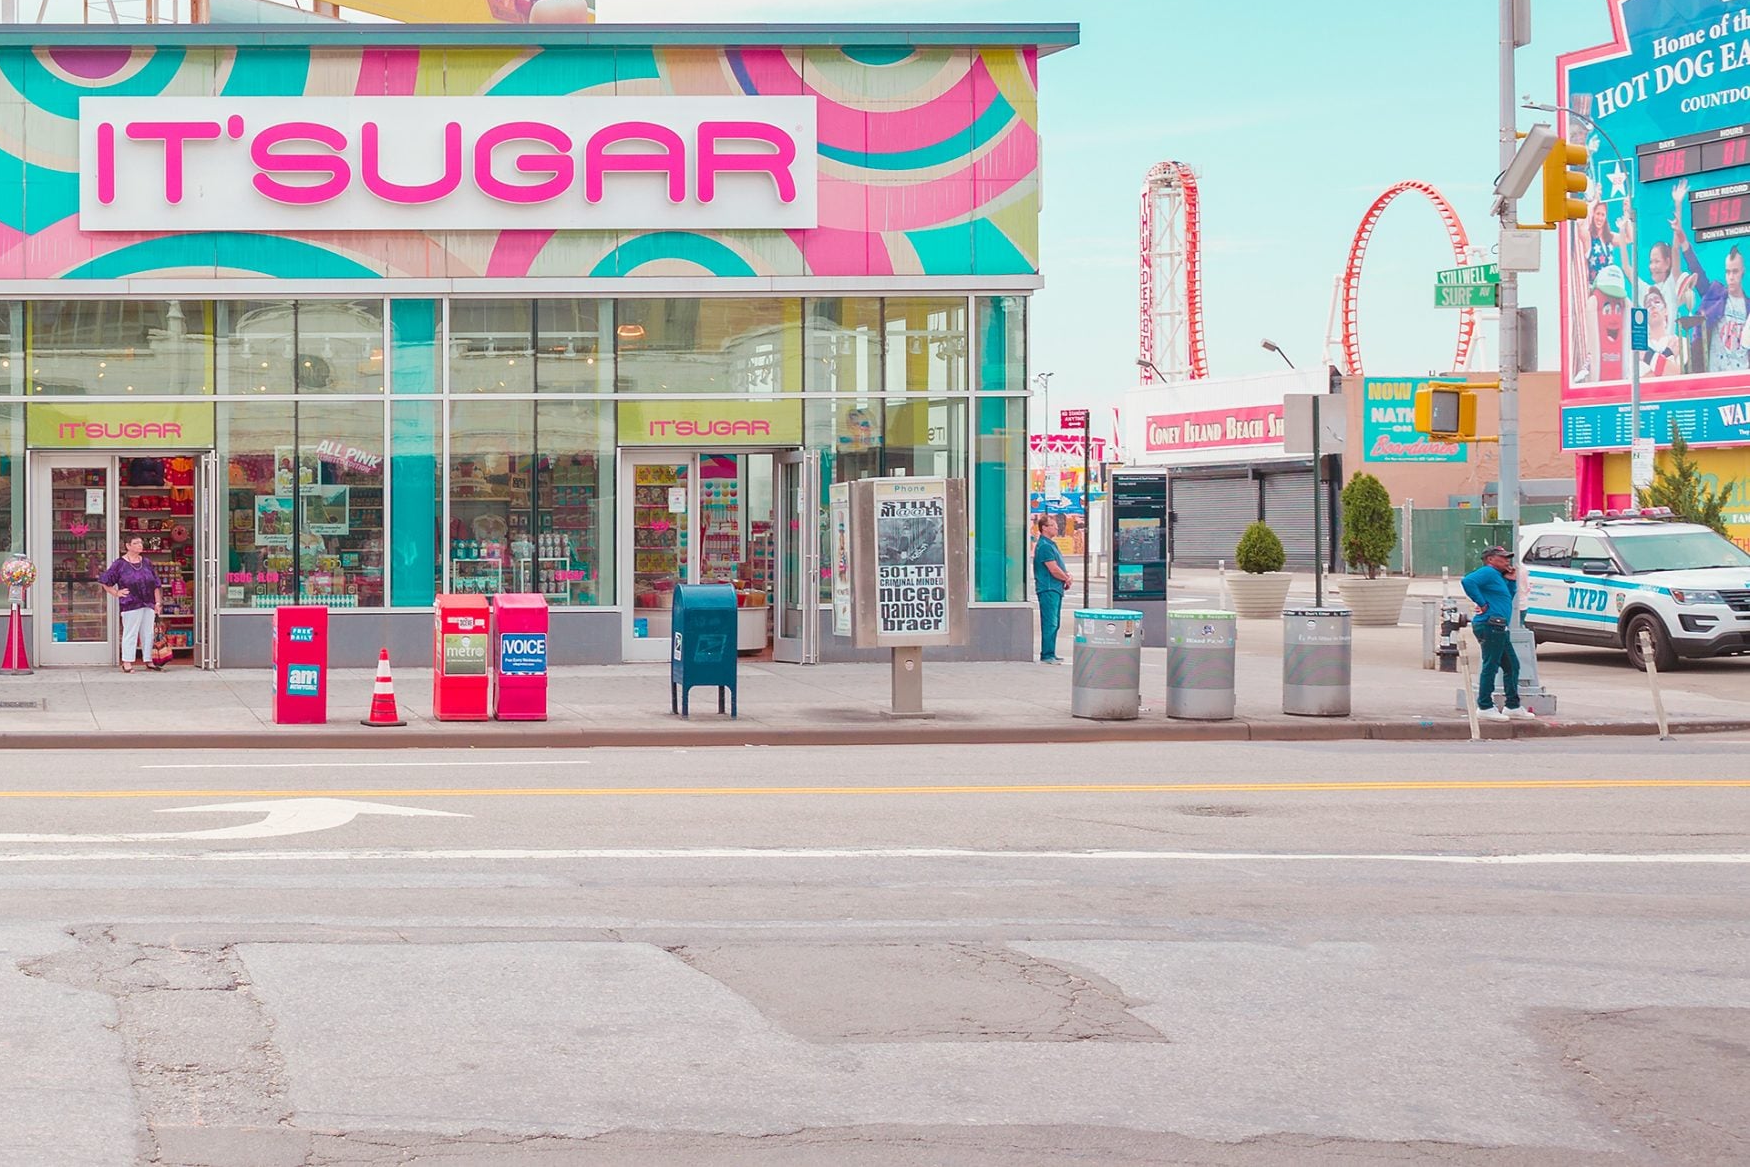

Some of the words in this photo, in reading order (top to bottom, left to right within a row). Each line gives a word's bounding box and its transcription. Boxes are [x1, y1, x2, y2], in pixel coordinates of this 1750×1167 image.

[1652, 29, 1705, 60] Home
[1709, 13, 1730, 40] of
[1595, 71, 1650, 120] HOT
[1654, 49, 1715, 95] DOG
[1658, 140, 1676, 150] DAYS
[96, 113, 797, 206] IT'SUGAR
[1440, 266, 1488, 284] STILLWELL
[1441, 287, 1474, 306] SURF
[1479, 287, 1490, 297] AV
[1368, 382, 1412, 400] NOW
[58, 421, 182, 439] IT'SUGAR
[649, 419, 771, 436] IT'SUGAR
[1392, 425, 1413, 433] ON
[316, 439, 343, 458] ALL
[345, 447, 382, 469] PINK
[894, 484, 926, 493] Phone
[882, 500, 940, 510] STILL
[879, 566, 944, 578] 501-TPT
[879, 577, 915, 588] CRIMINAL
[915, 577, 944, 586] MINDED
[879, 587, 945, 603] niceo
[1566, 587, 1608, 612] NYPD
[883, 617, 943, 631] braer
[446, 646, 485, 657] metro
[289, 669, 318, 685] am
